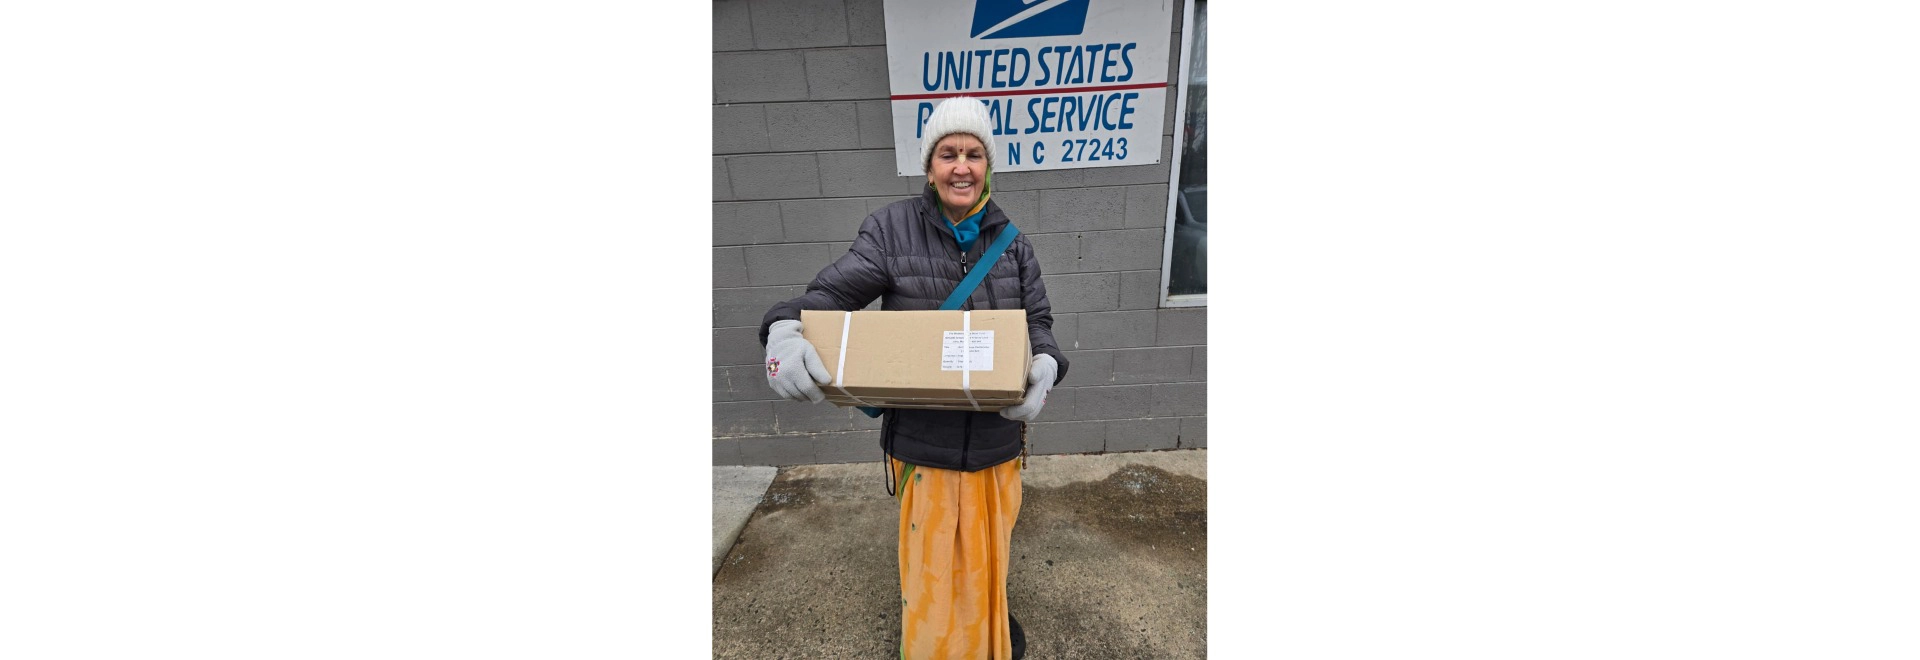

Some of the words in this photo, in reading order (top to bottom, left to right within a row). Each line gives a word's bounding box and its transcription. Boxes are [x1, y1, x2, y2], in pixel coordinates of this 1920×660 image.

[923, 48, 1031, 92] UNITED
[1035, 42, 1137, 87] STATES
[916, 98, 1018, 139] PAL
[1024, 93, 1139, 135] SERVICE
[1009, 143, 1020, 165] N
[1032, 141, 1045, 165] C
[1061, 137, 1128, 163] 27243
